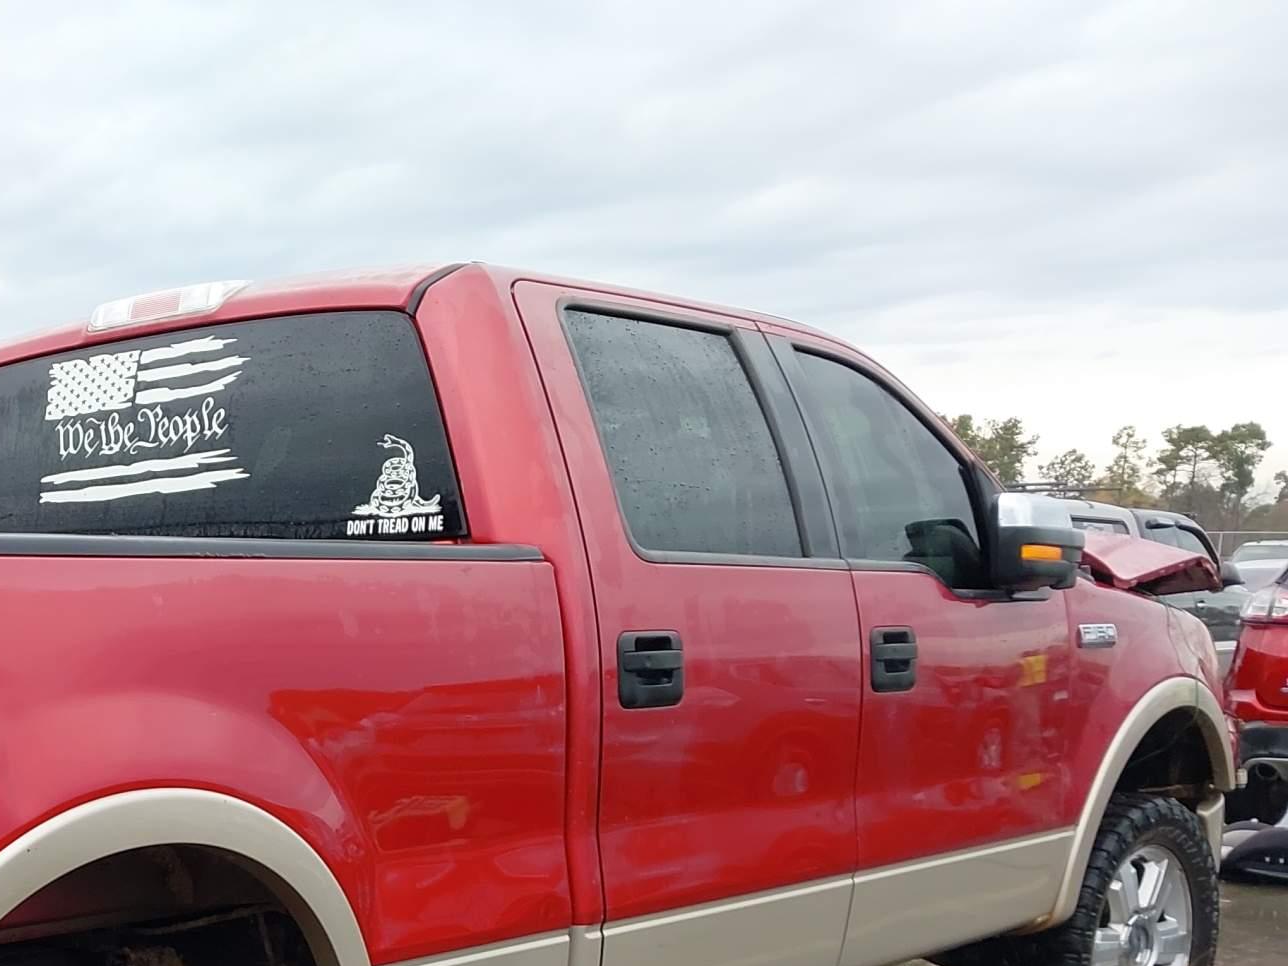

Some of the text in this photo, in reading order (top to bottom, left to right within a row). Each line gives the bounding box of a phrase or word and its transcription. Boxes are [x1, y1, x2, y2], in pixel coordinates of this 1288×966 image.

[55, 418, 99, 460] We
[131, 397, 228, 454] People
[346, 514, 444, 536] DON'T TREAD ON ME
